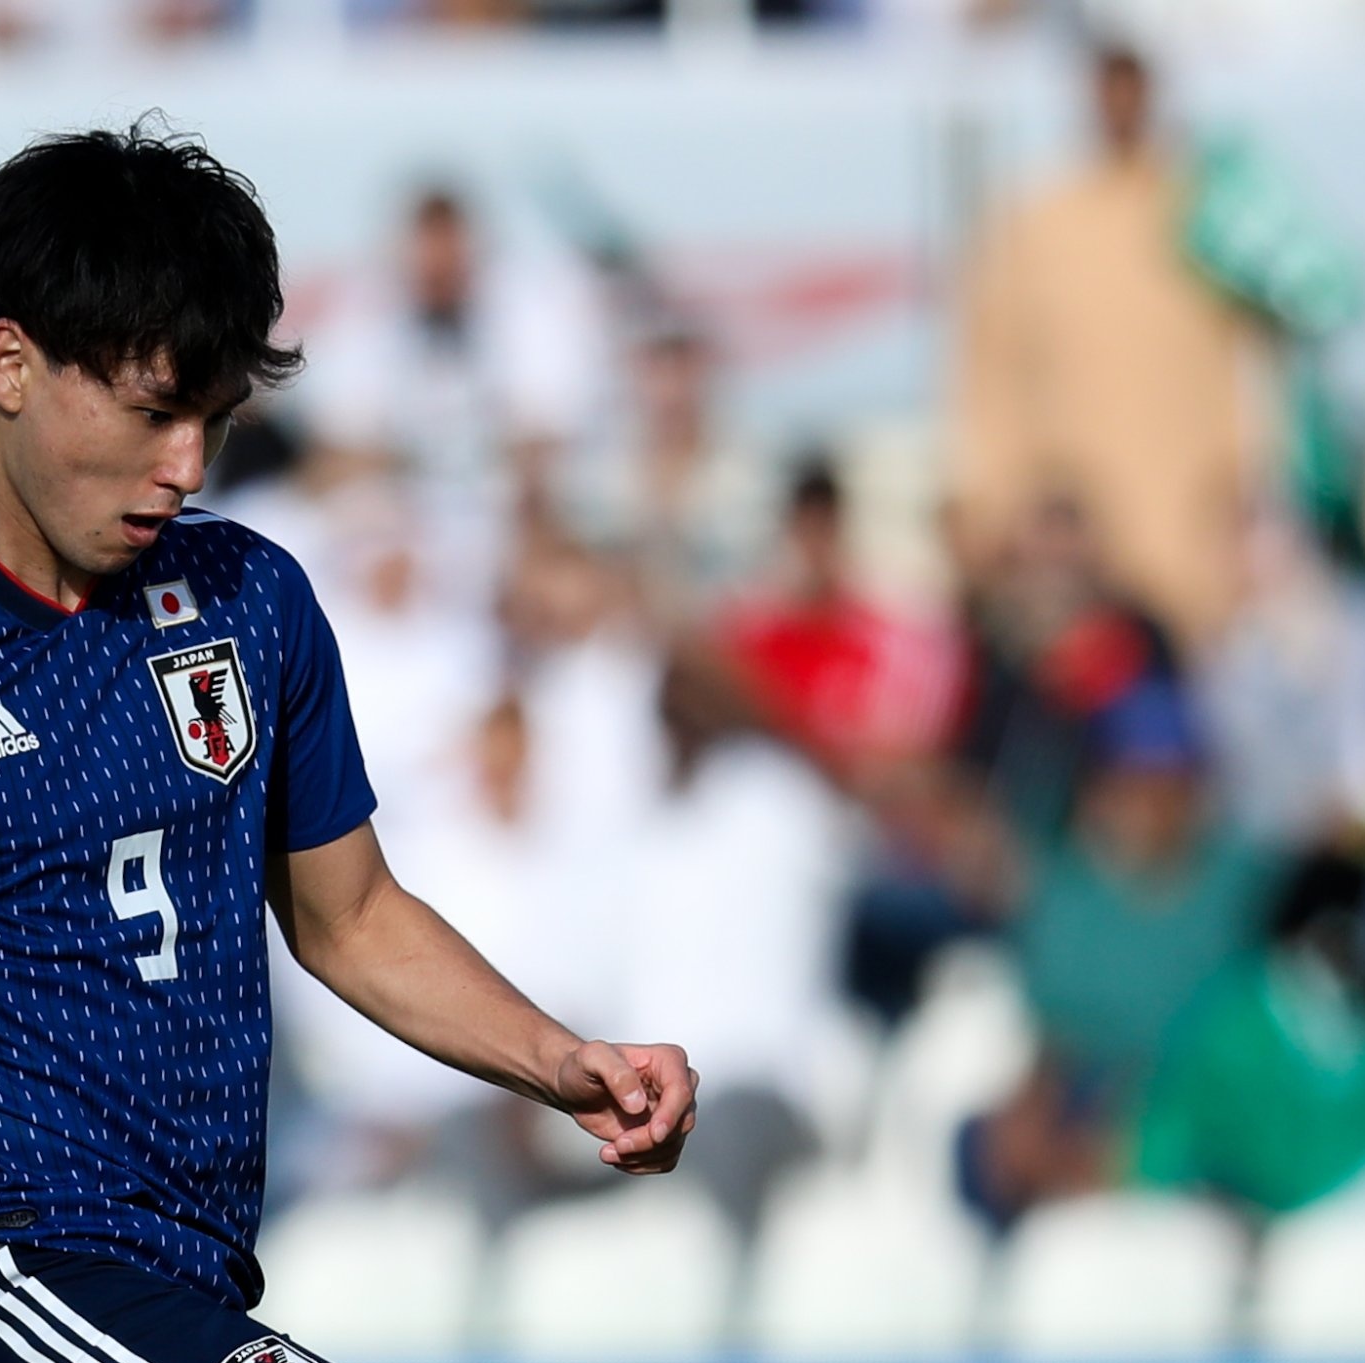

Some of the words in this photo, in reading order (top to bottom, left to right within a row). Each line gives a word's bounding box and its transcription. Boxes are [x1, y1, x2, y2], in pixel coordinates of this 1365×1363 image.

[172, 648, 216, 669] JAPAN
[107, 828, 178, 982] 9
[234, 1340, 268, 1363] JAPAN
